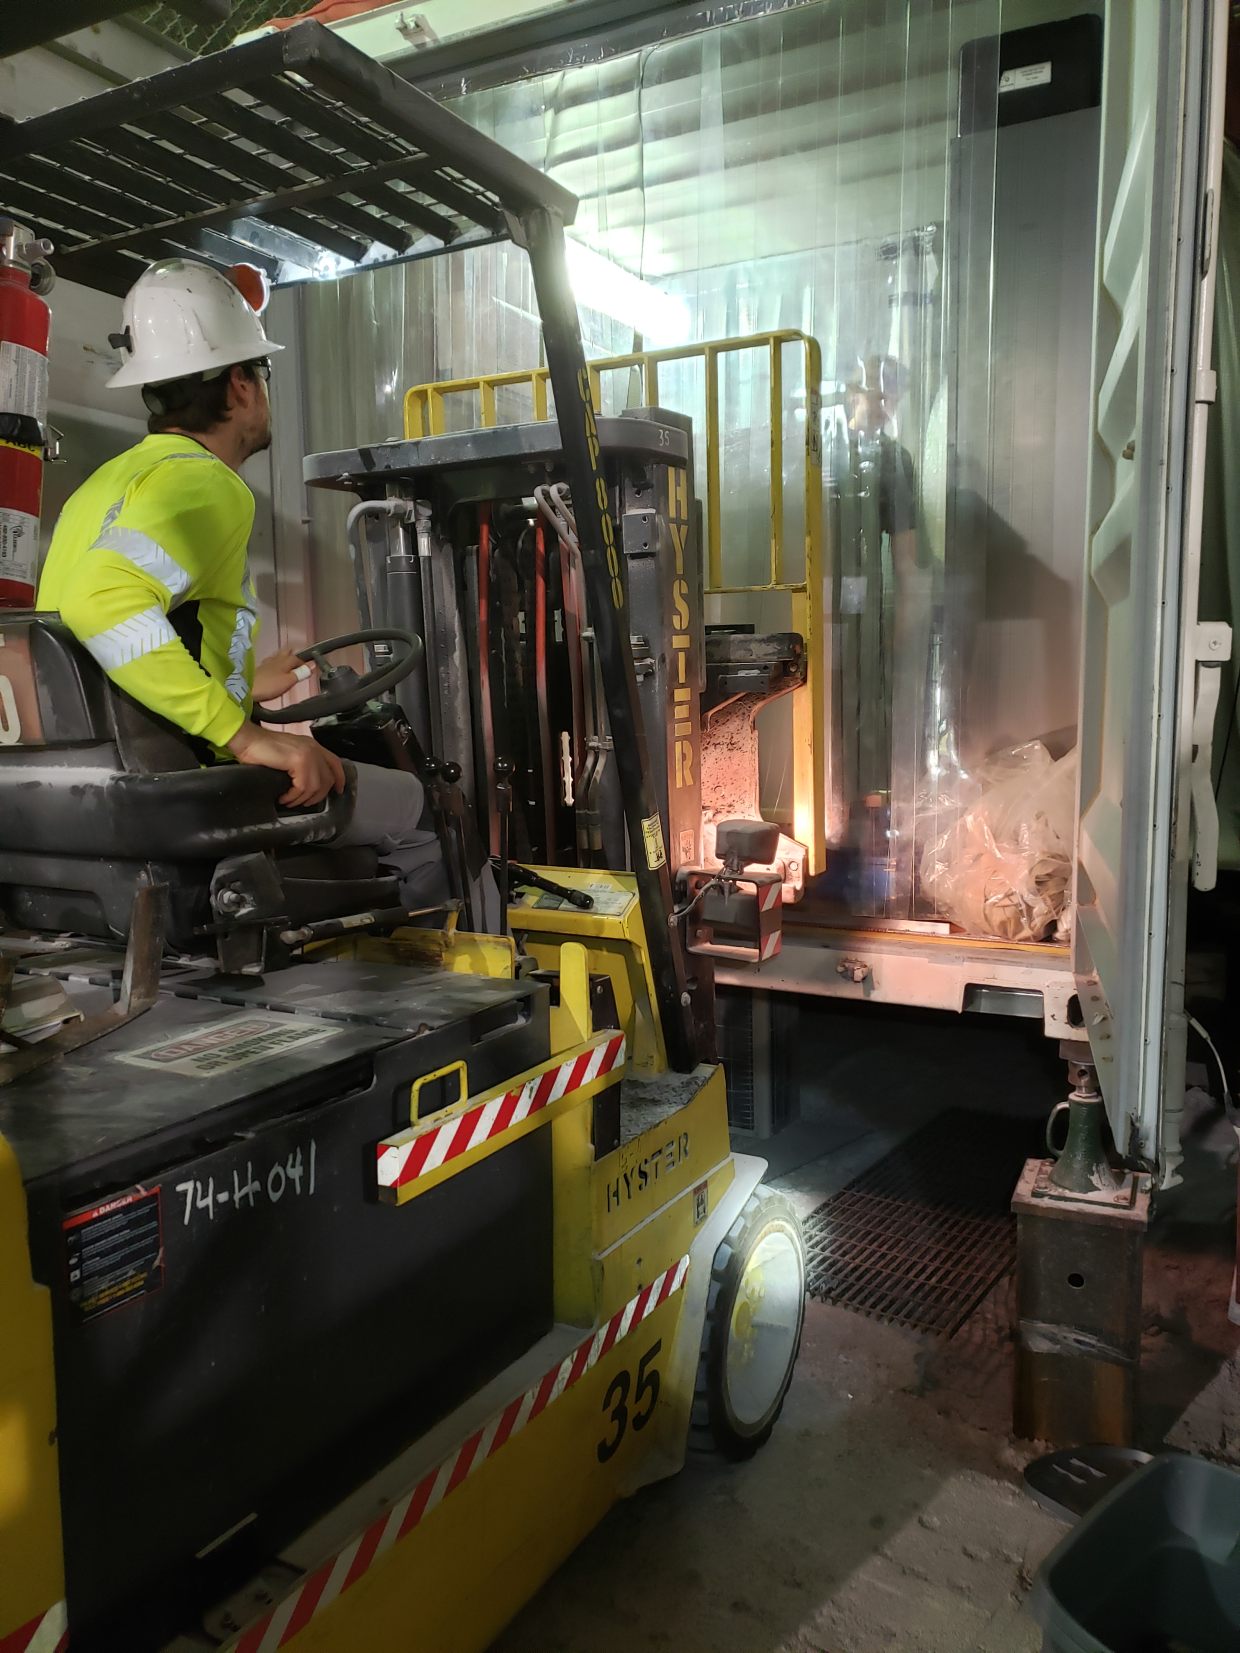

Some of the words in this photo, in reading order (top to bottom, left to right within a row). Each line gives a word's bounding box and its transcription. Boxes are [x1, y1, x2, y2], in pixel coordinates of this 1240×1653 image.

[659, 429, 670, 446] 35
[578, 368, 600, 471] CAP
[595, 477, 624, 609] 8000
[668, 466, 694, 788] HYSTER
[160, 1024, 259, 1057] DANGER
[190, 1053, 222, 1062] NO
[219, 1029, 297, 1053] SMOKING
[195, 1060, 228, 1071] OR
[223, 1046, 275, 1061] OPEN
[269, 1028, 326, 1046] FLAME
[607, 1132, 690, 1213] HYSTER
[597, 1338, 662, 1463] 35
